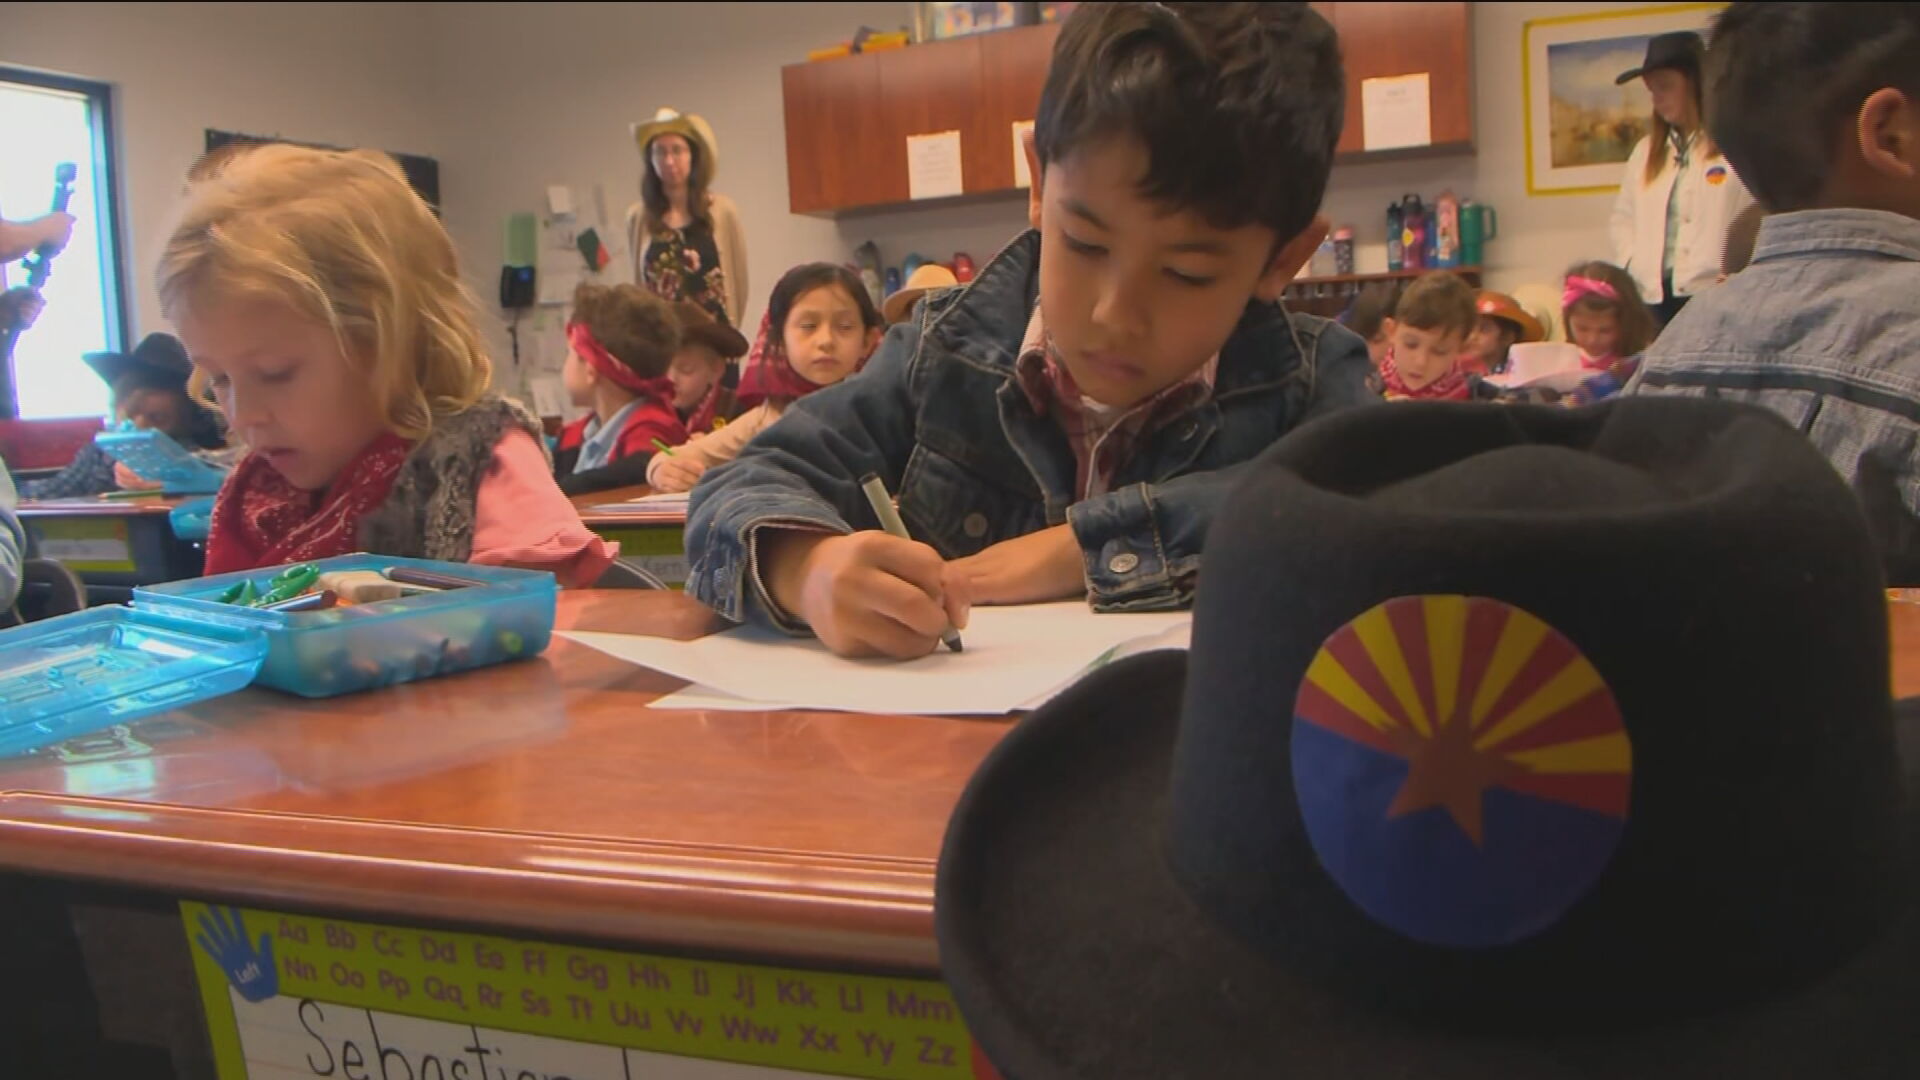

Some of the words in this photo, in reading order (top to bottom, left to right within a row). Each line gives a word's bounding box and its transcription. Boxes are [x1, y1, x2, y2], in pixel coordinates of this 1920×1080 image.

[233, 963, 262, 985] Left
[279, 919, 307, 943] Aa
[324, 925, 354, 950] Bb
[373, 931, 403, 956] Cc
[420, 937, 456, 963] Dd
[475, 945, 503, 969] Ee
[523, 950, 544, 974] Ff
[568, 956, 607, 991] Gg
[628, 964, 669, 990] Hh
[693, 969, 708, 995] Ii
[735, 976, 753, 1008] Jj
[776, 979, 817, 1007] Kk
[839, 985, 862, 1012] Ll
[887, 989, 953, 1020] Mm
[284, 958, 315, 981] Nn
[331, 963, 363, 987] Oo
[378, 970, 409, 997] Pp
[425, 977, 468, 1011] Qq
[479, 984, 502, 1007] Rr
[521, 990, 549, 1016] Ss
[568, 996, 591, 1020] Tt
[611, 1001, 648, 1030] Uu
[667, 1009, 702, 1035] Vv
[721, 1016, 778, 1044] Ww
[800, 1024, 838, 1052] Xx
[857, 1032, 894, 1065] Yy
[917, 1037, 955, 1066] Zz
[298, 998, 576, 1080] Sebasti
